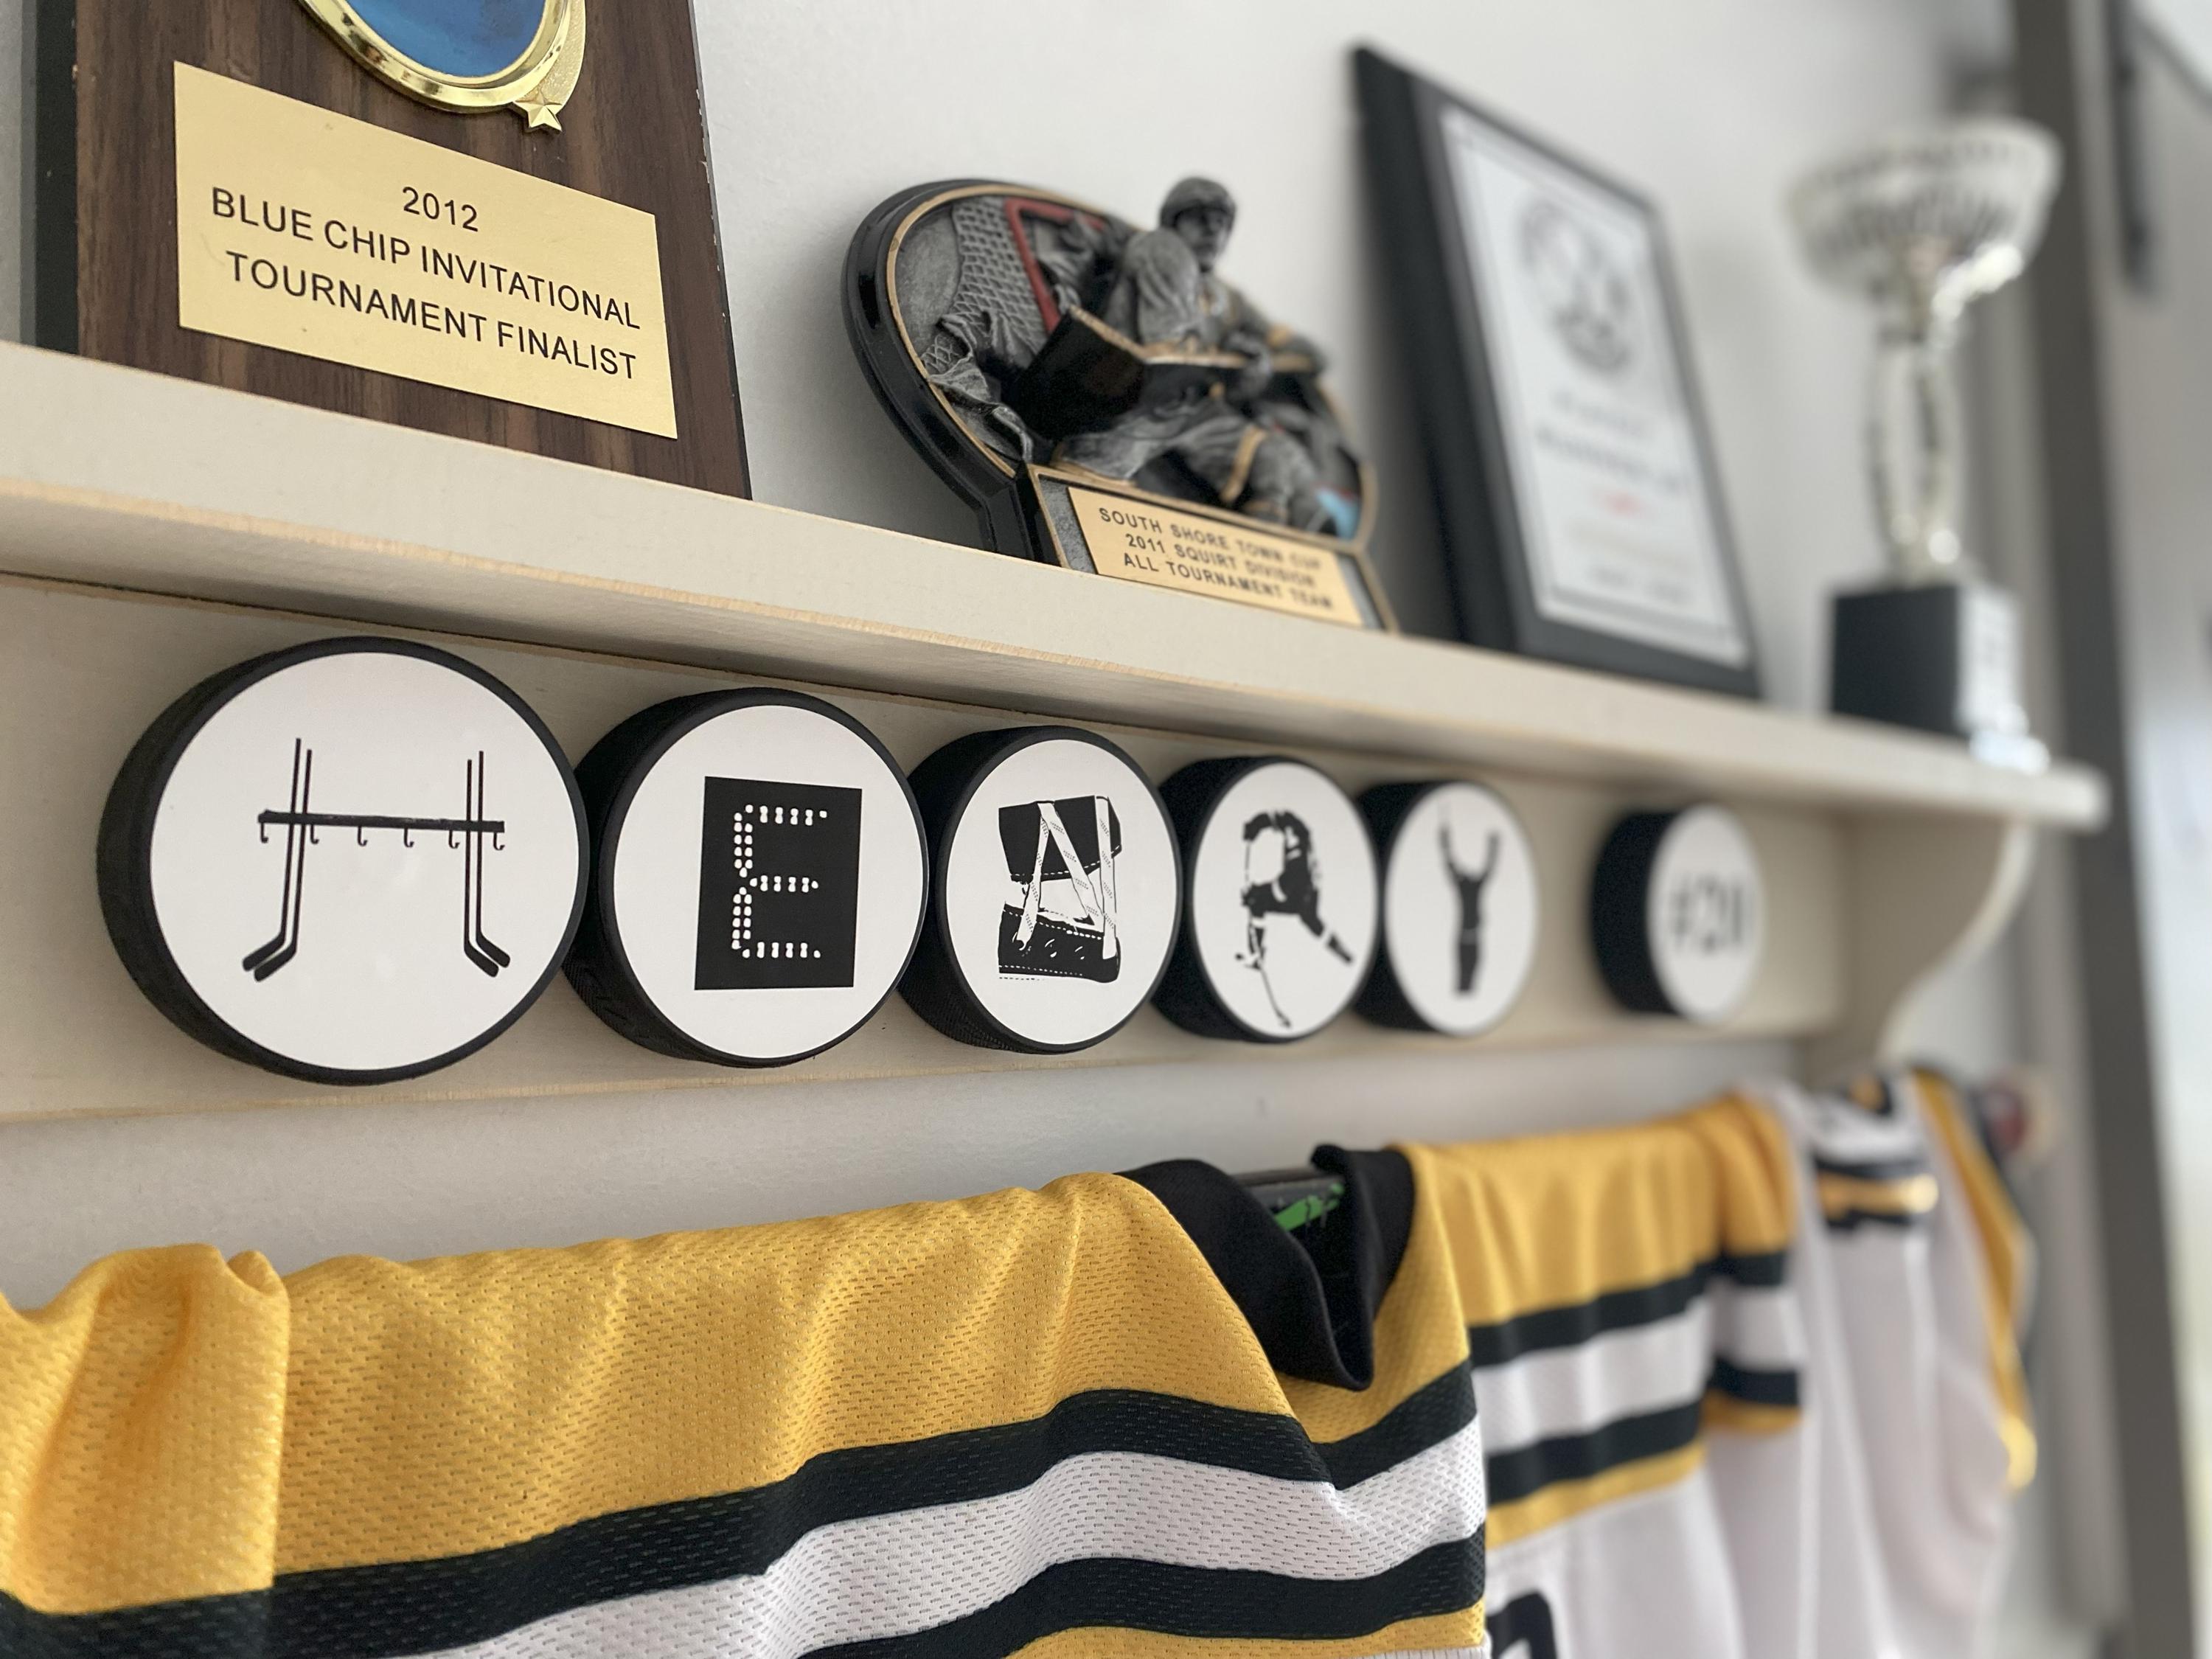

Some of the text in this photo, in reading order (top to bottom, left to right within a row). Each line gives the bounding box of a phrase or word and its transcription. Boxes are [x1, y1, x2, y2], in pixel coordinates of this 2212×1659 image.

[401, 187, 479, 232] 2012
[212, 187, 641, 329] BLUE CHIP INVITATIONAL
[226, 250, 636, 380] TOURNAMENT FINALIST
[1099, 507, 1163, 534] SOUTH
[1170, 524, 1230, 550] SHORE
[1236, 539, 1283, 562] TOWN
[1125, 533, 1315, 588] 2011 SQUIRT DIVISION
[1124, 552, 1333, 608] ALL TOURNAMENT TEAM
